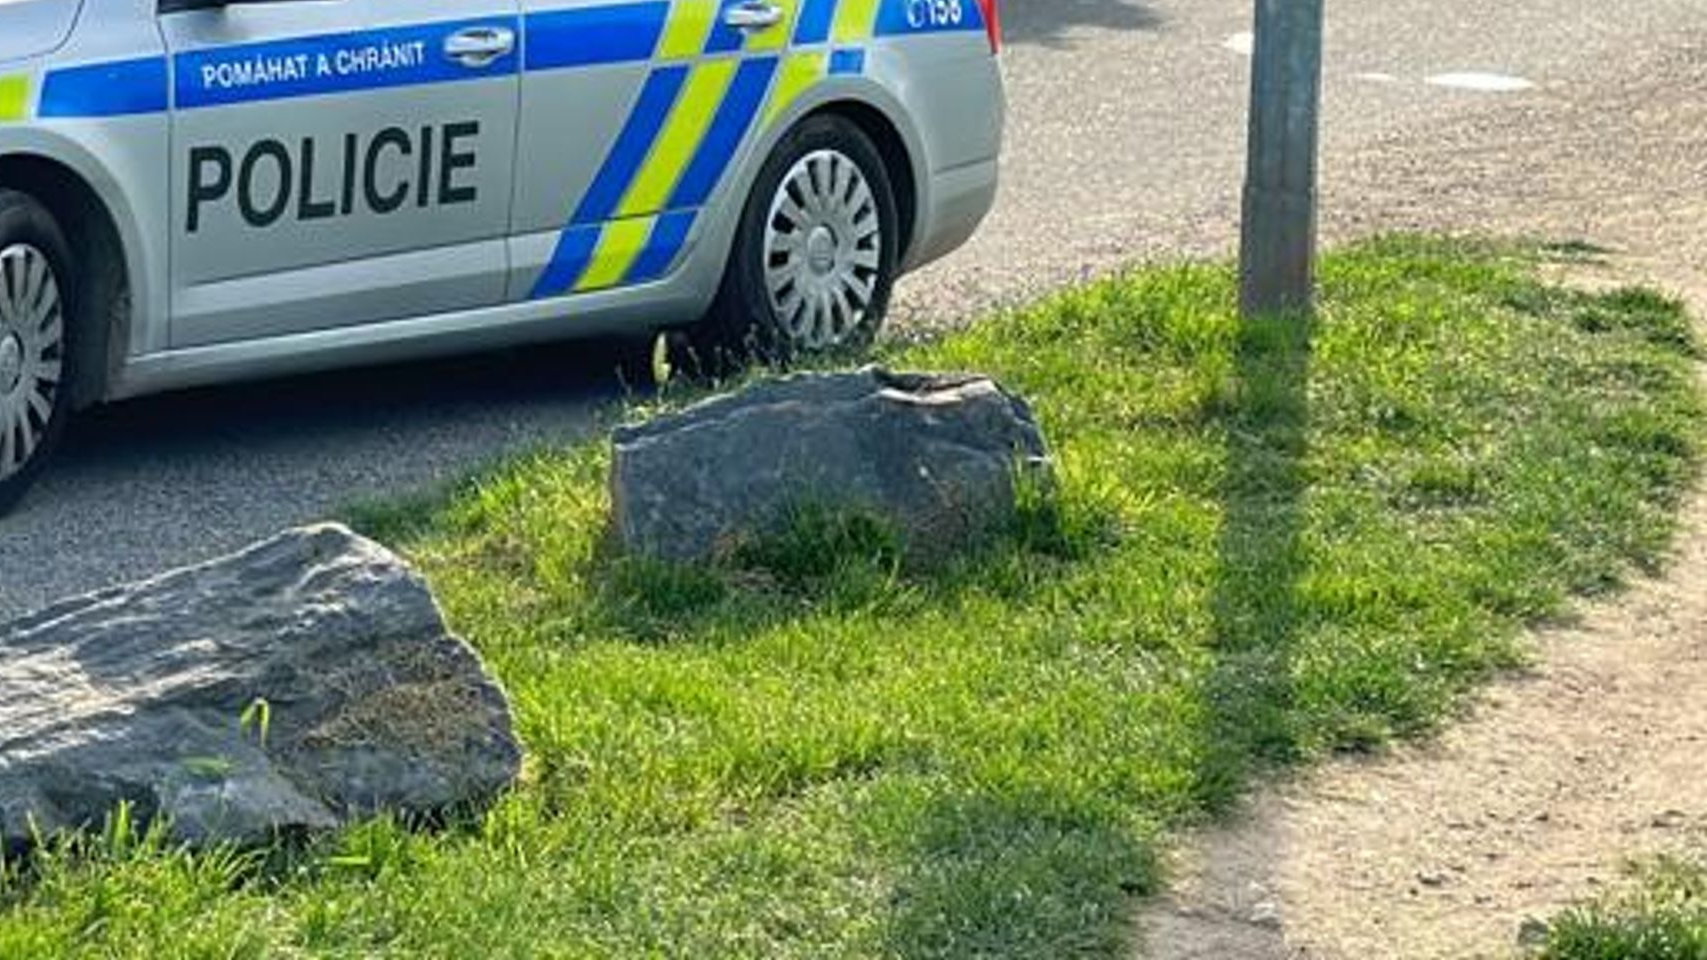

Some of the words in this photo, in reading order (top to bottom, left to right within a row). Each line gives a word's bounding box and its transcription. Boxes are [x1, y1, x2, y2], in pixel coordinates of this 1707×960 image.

[201, 54, 308, 89] POMÁHAT
[316, 54, 332, 76] A
[337, 41, 425, 74] CHRÁNIT
[186, 120, 479, 233] POLICIE
